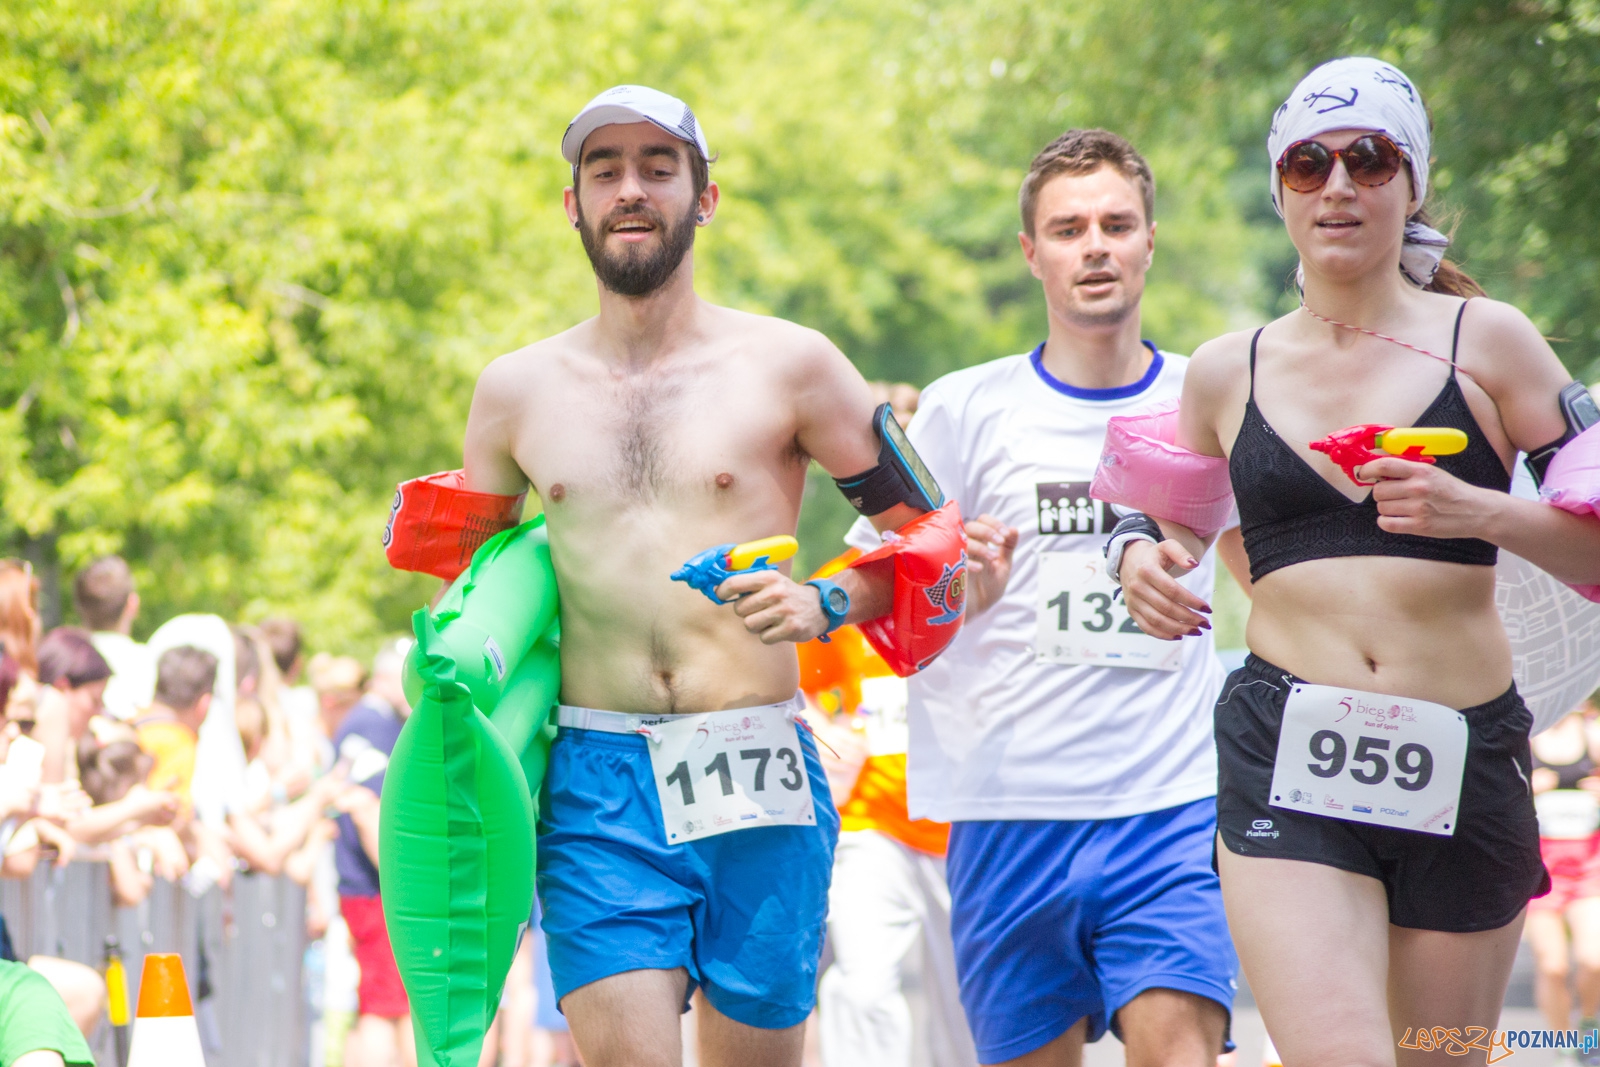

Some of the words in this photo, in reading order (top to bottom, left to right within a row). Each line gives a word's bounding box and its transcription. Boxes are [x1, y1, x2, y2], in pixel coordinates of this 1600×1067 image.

[1335, 697, 1353, 723] 5
[1356, 700, 1385, 722] bieg
[1401, 705, 1413, 713] na
[1401, 713, 1418, 723] tak
[696, 722, 709, 749] 5
[713, 721, 741, 735] bieg
[1364, 720, 1376, 728] Run
[1384, 723, 1399, 731] Spirit
[1307, 730, 1433, 791] 959
[666, 747, 803, 806] 1173
